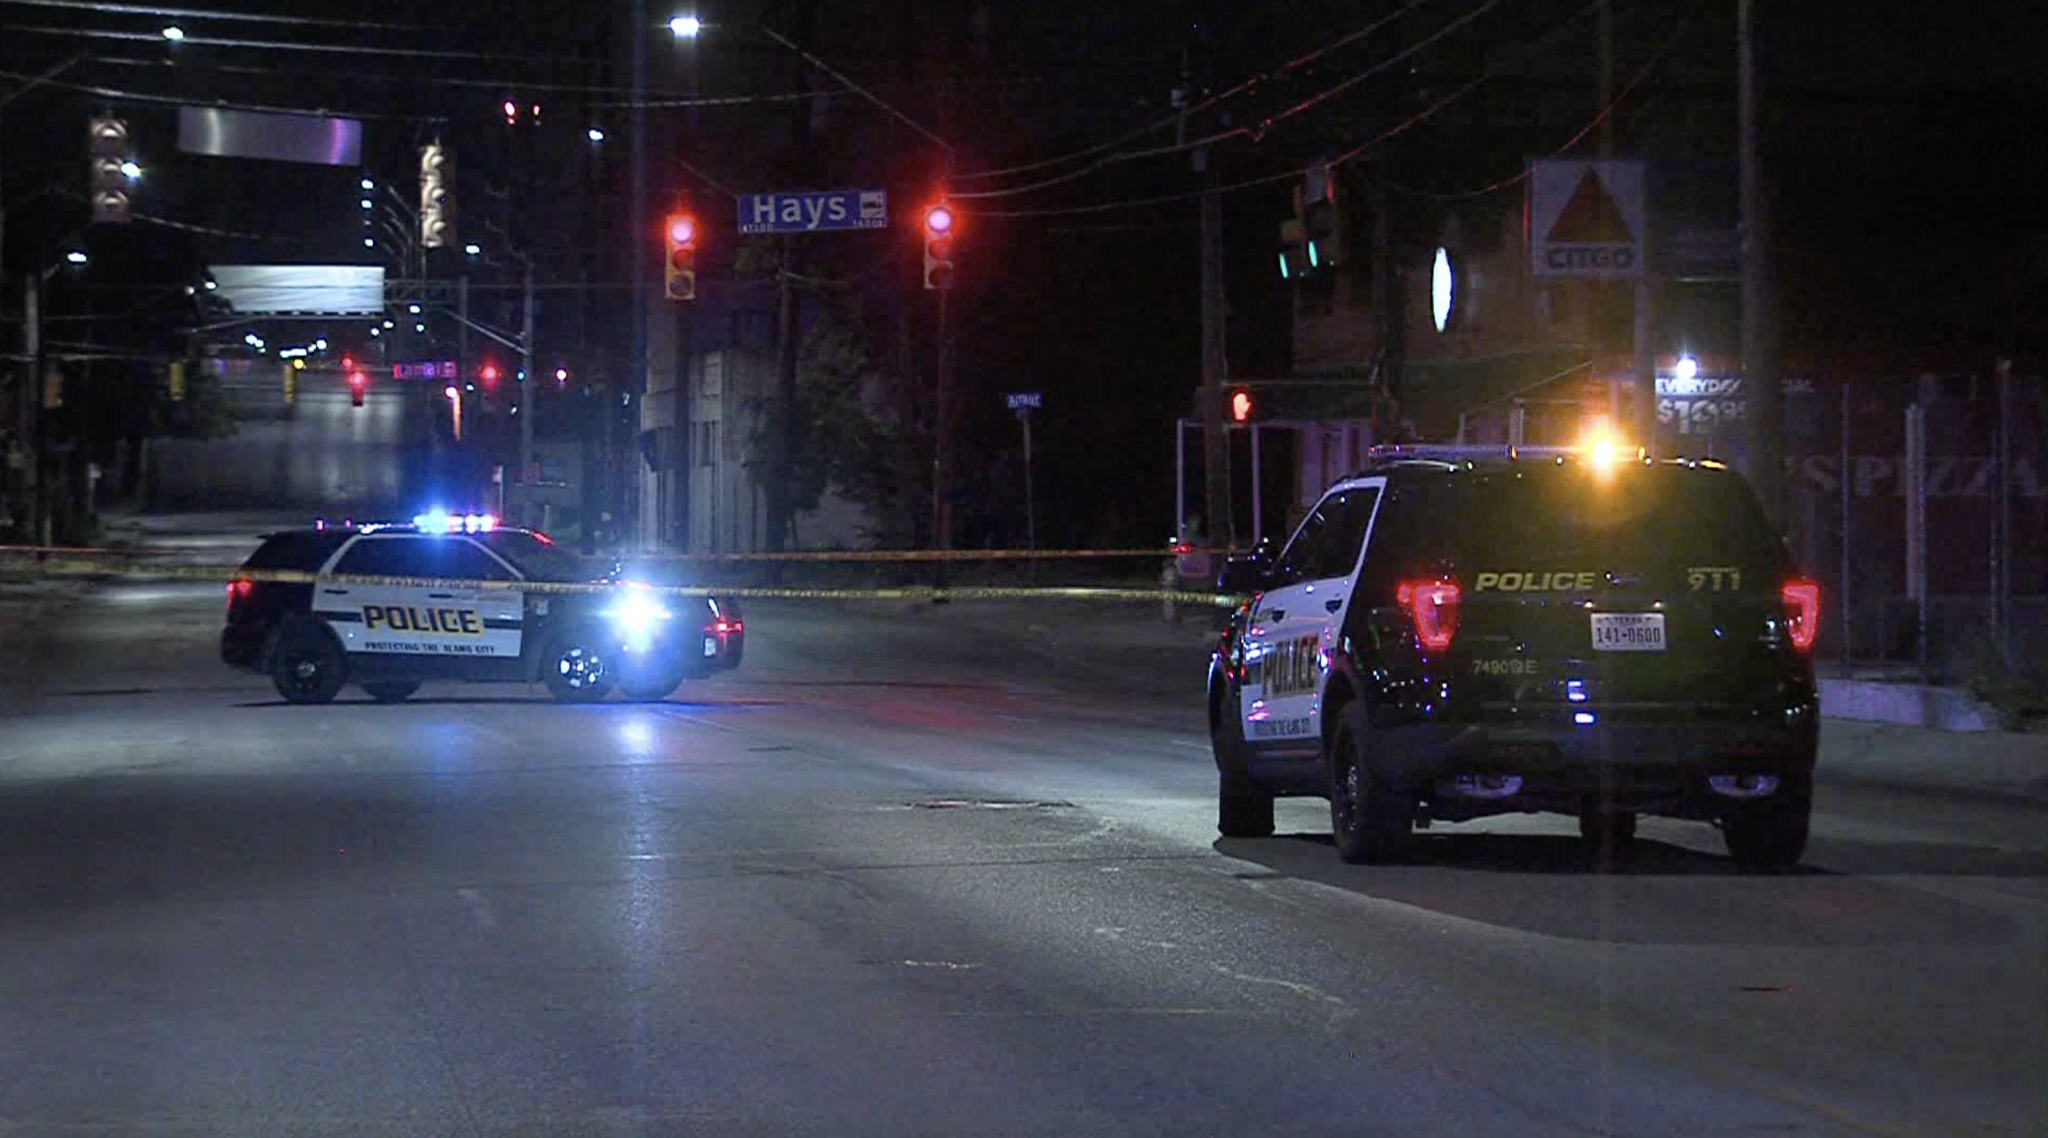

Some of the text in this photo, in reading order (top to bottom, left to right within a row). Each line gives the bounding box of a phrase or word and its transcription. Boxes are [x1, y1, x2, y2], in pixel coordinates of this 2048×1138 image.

[754, 195, 846, 229] Hays
[1546, 249, 1635, 269] CITGO
[1475, 573, 1596, 591] POLICE
[1688, 573, 1741, 591] 911
[362, 605, 480, 634] POLICE
[365, 641, 419, 651] PROTECTING
[423, 643, 438, 651] THE
